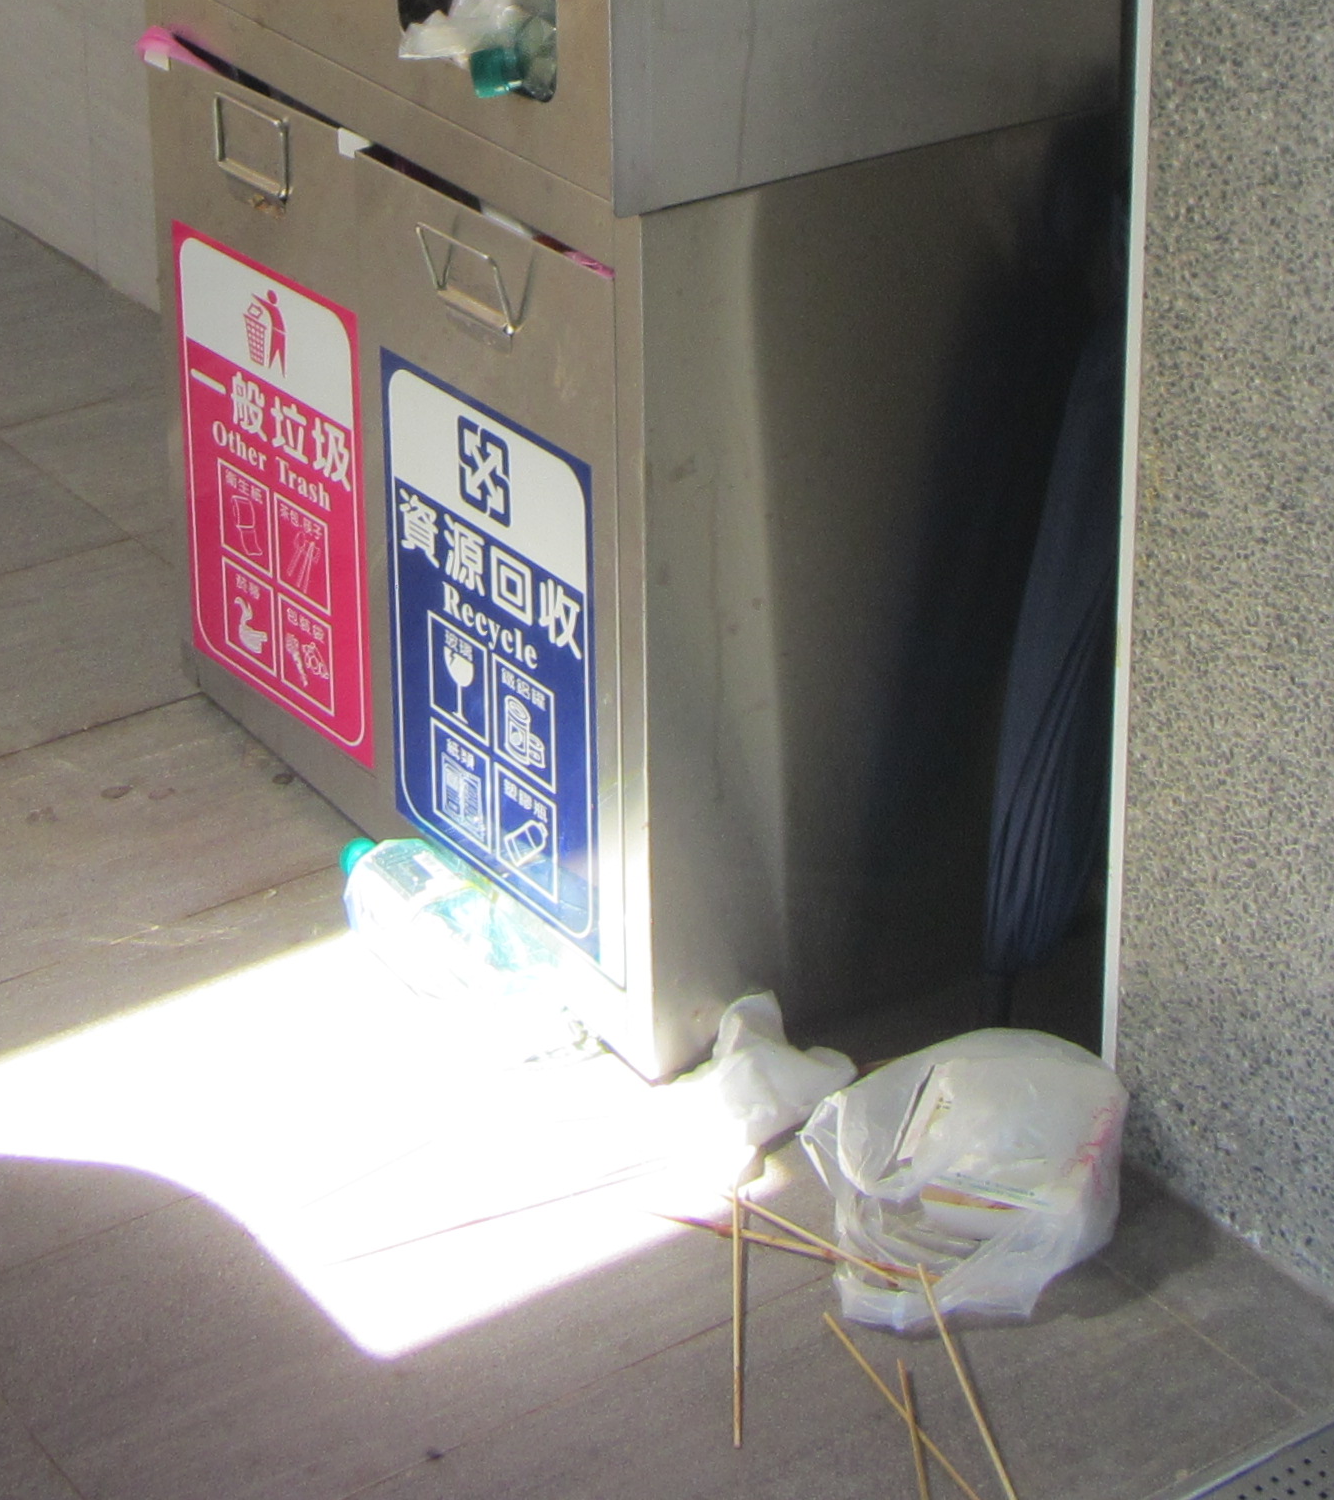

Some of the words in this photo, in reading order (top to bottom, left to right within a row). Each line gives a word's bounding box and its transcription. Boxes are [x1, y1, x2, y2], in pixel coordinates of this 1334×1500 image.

[190, 371, 352, 492] 一般垃圾
[211, 419, 267, 472] Other
[274, 455, 331, 513] Trash
[399, 487, 583, 661] 資源回收
[441, 580, 539, 670] Recycle
